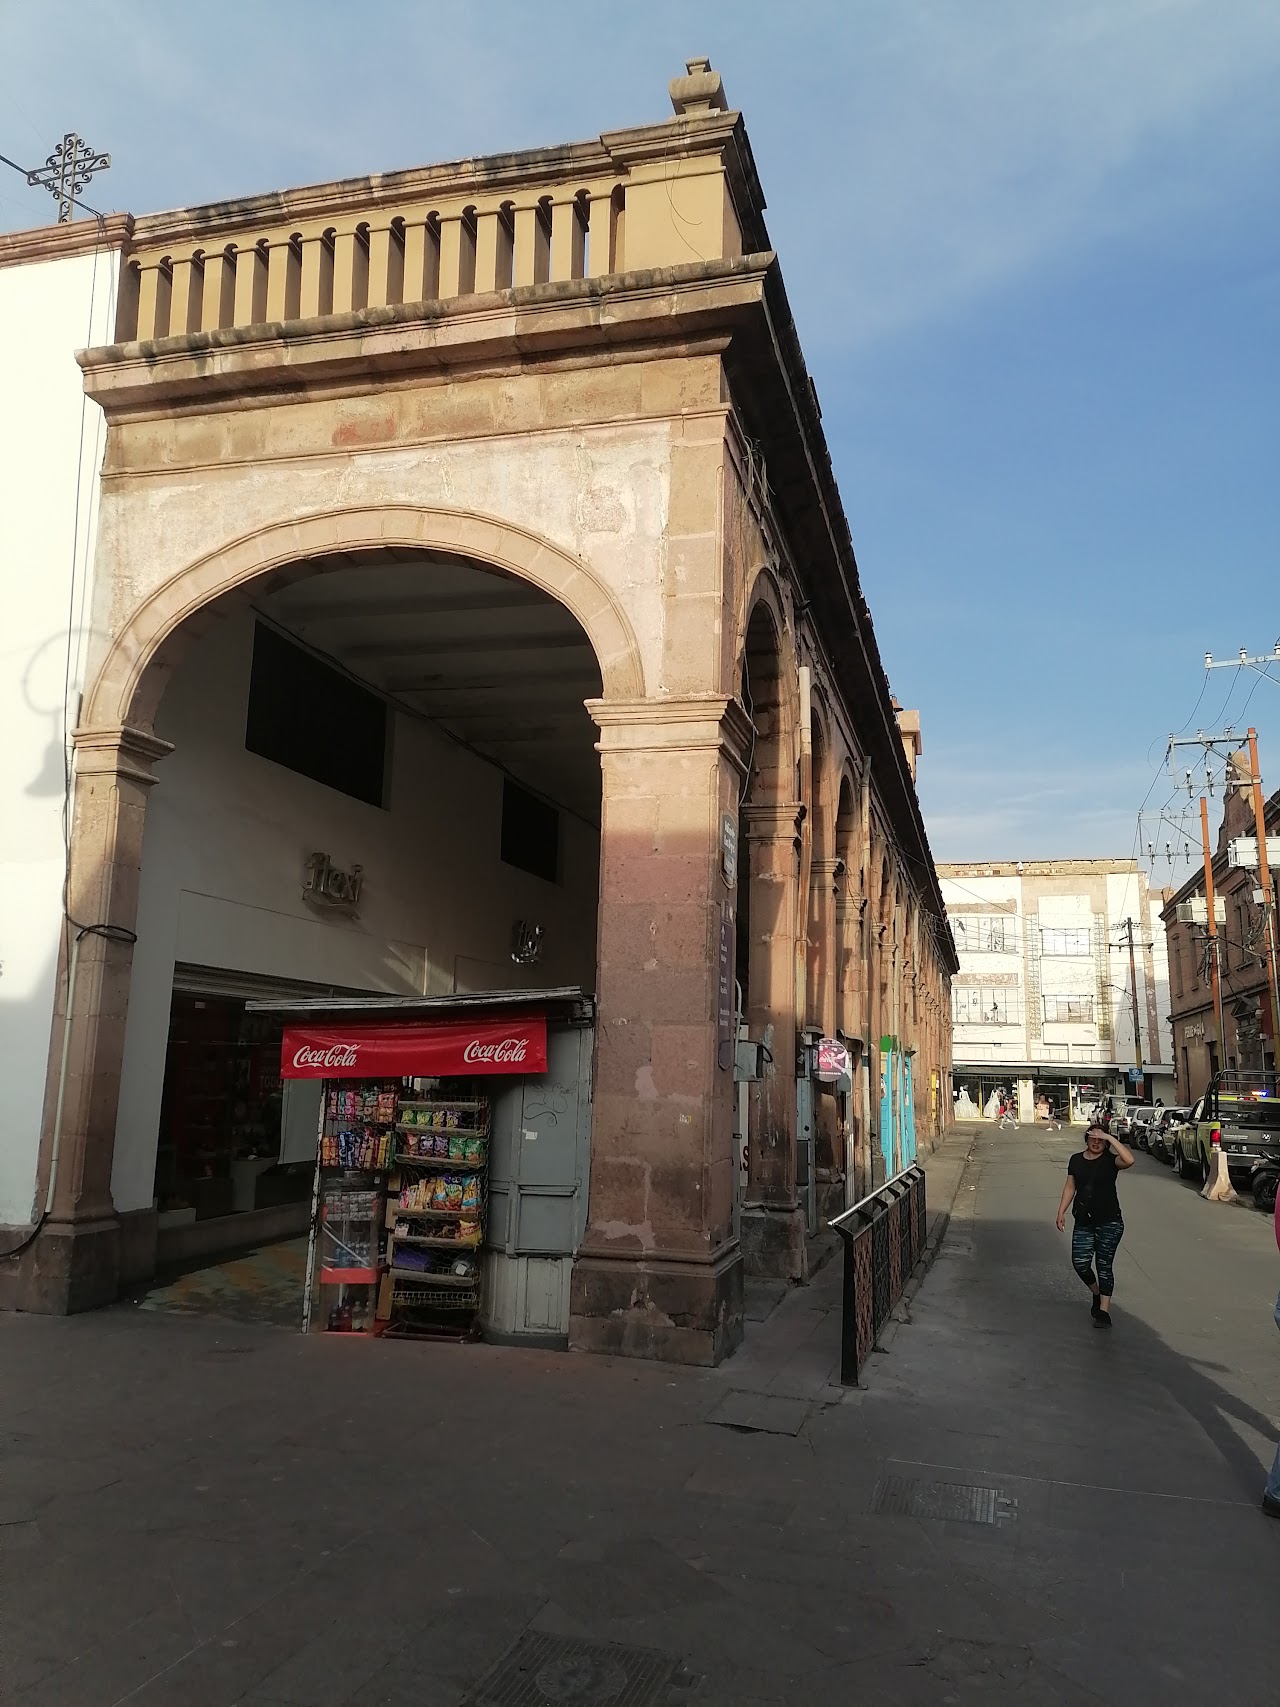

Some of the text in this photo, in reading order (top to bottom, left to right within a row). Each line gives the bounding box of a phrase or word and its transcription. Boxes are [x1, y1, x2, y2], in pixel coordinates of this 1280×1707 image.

[304, 852, 363, 901] flexi
[293, 1044, 361, 1068] Coca-Cola
[464, 1039, 529, 1062] Coca-Cola
